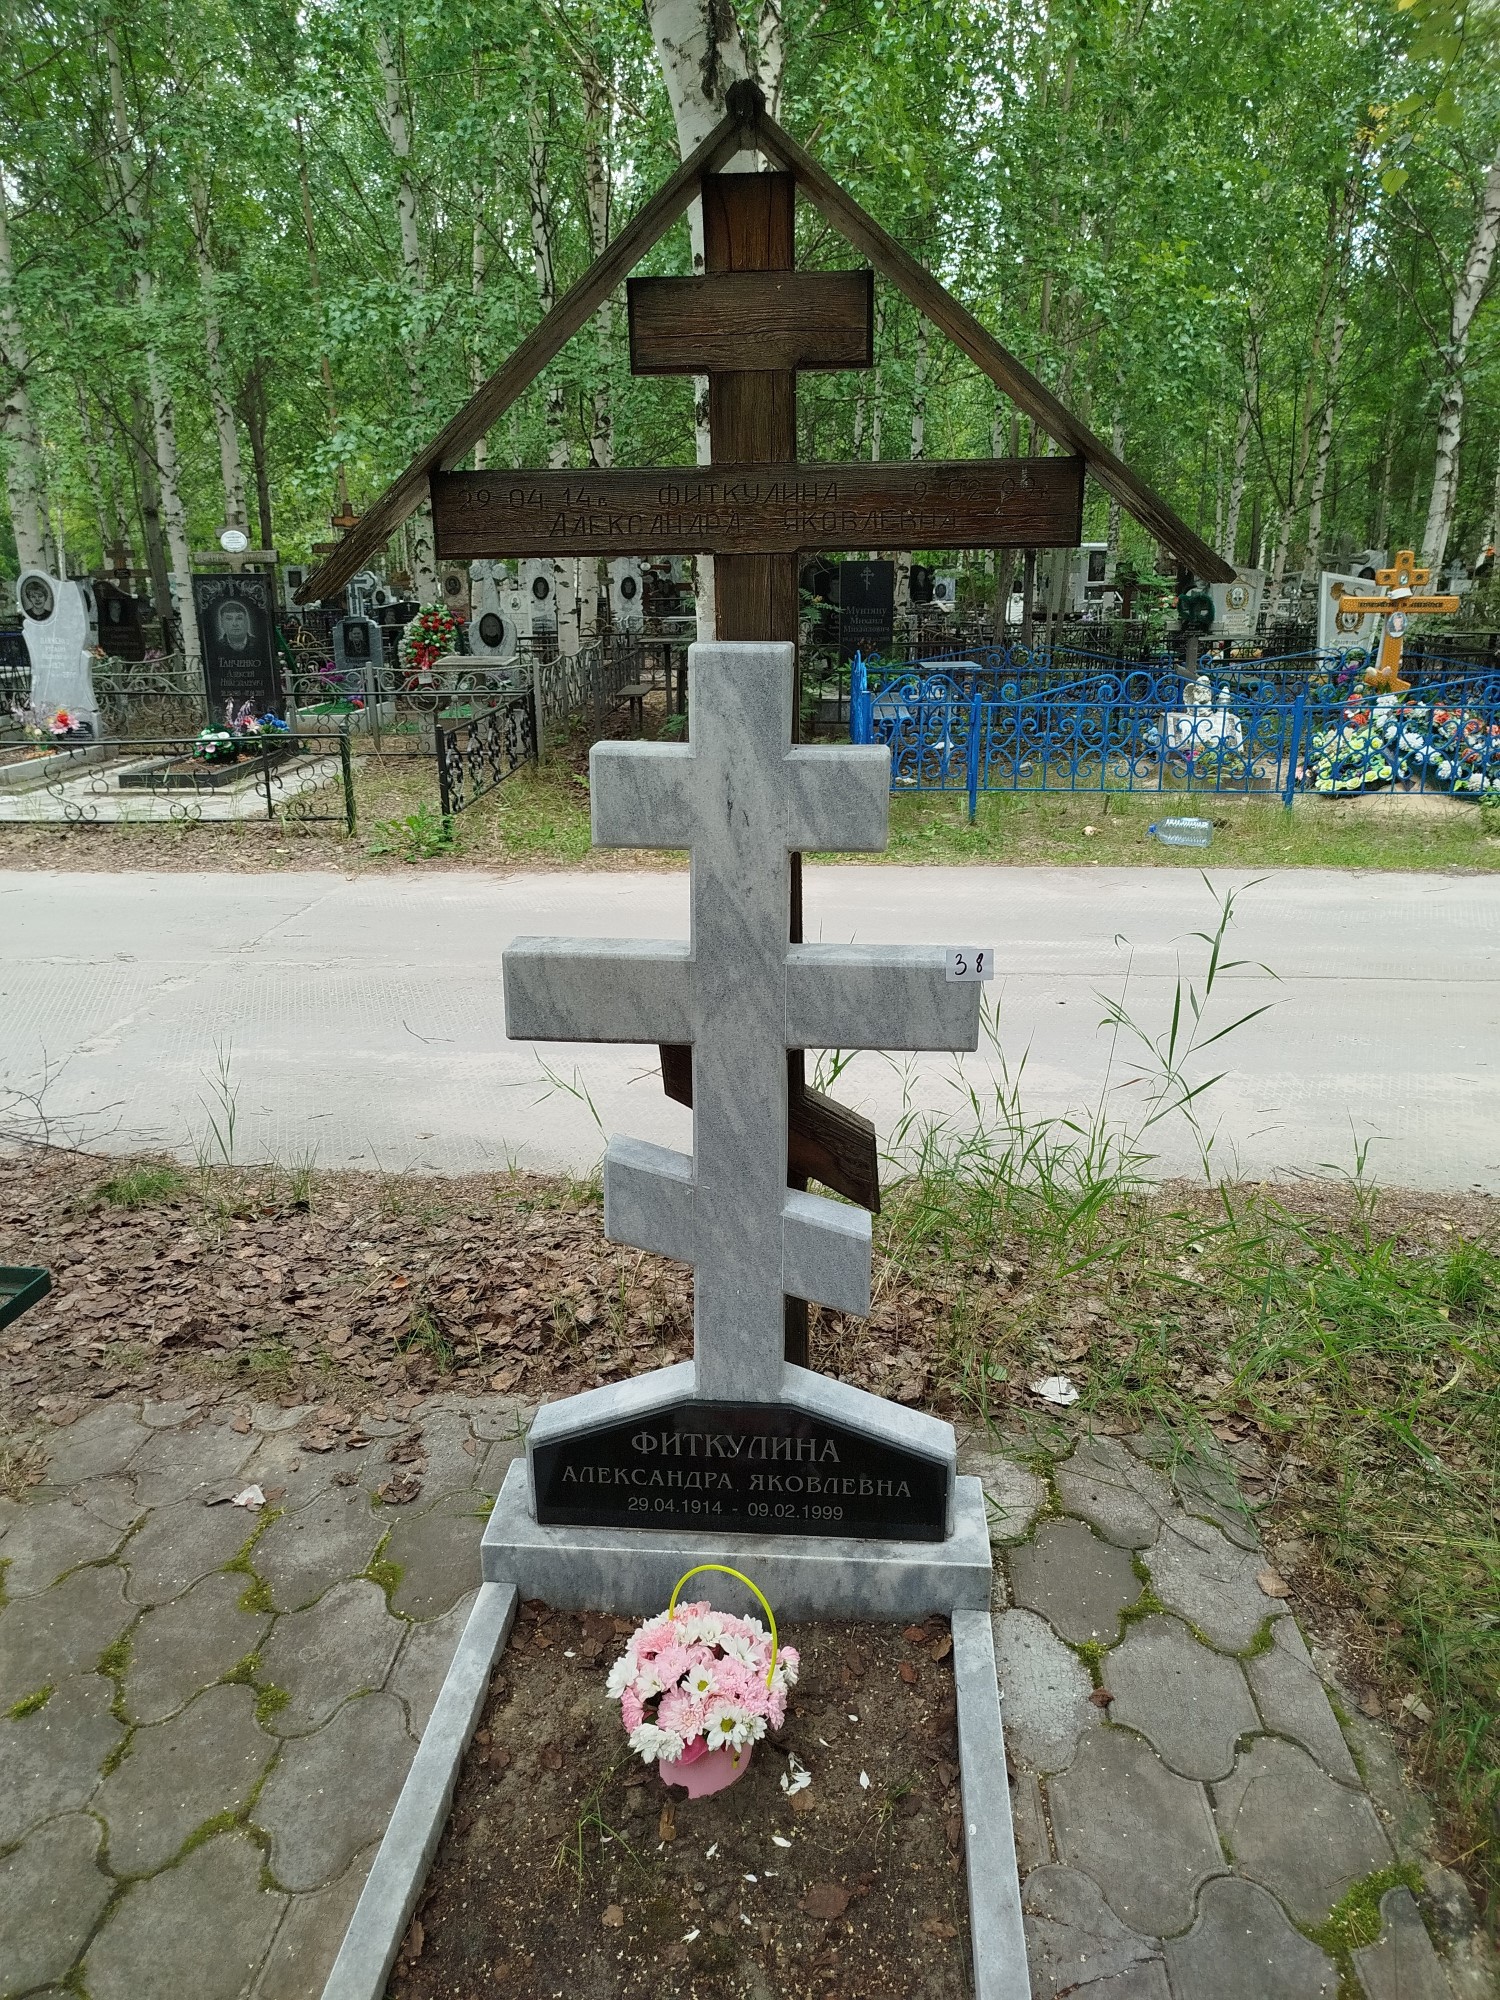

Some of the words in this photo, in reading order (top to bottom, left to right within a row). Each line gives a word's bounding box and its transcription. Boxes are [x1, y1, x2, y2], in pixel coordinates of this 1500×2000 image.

[658, 482, 838, 506] ФИТКУЛИНА
[550, 512, 741, 537] АЛЕКСАНДРА
[784, 508, 956, 532] ЯКОВЛЕВНА
[631, 1431, 841, 1463] ФИТКУЛИНА
[561, 1465, 733, 1491] АЛЕКСАНДРА
[749, 1474, 912, 1498] ЯКОВЛЕВНА
[627, 1496, 723, 1515] 29.04.1914
[747, 1502, 844, 1521] 09.02.1999
